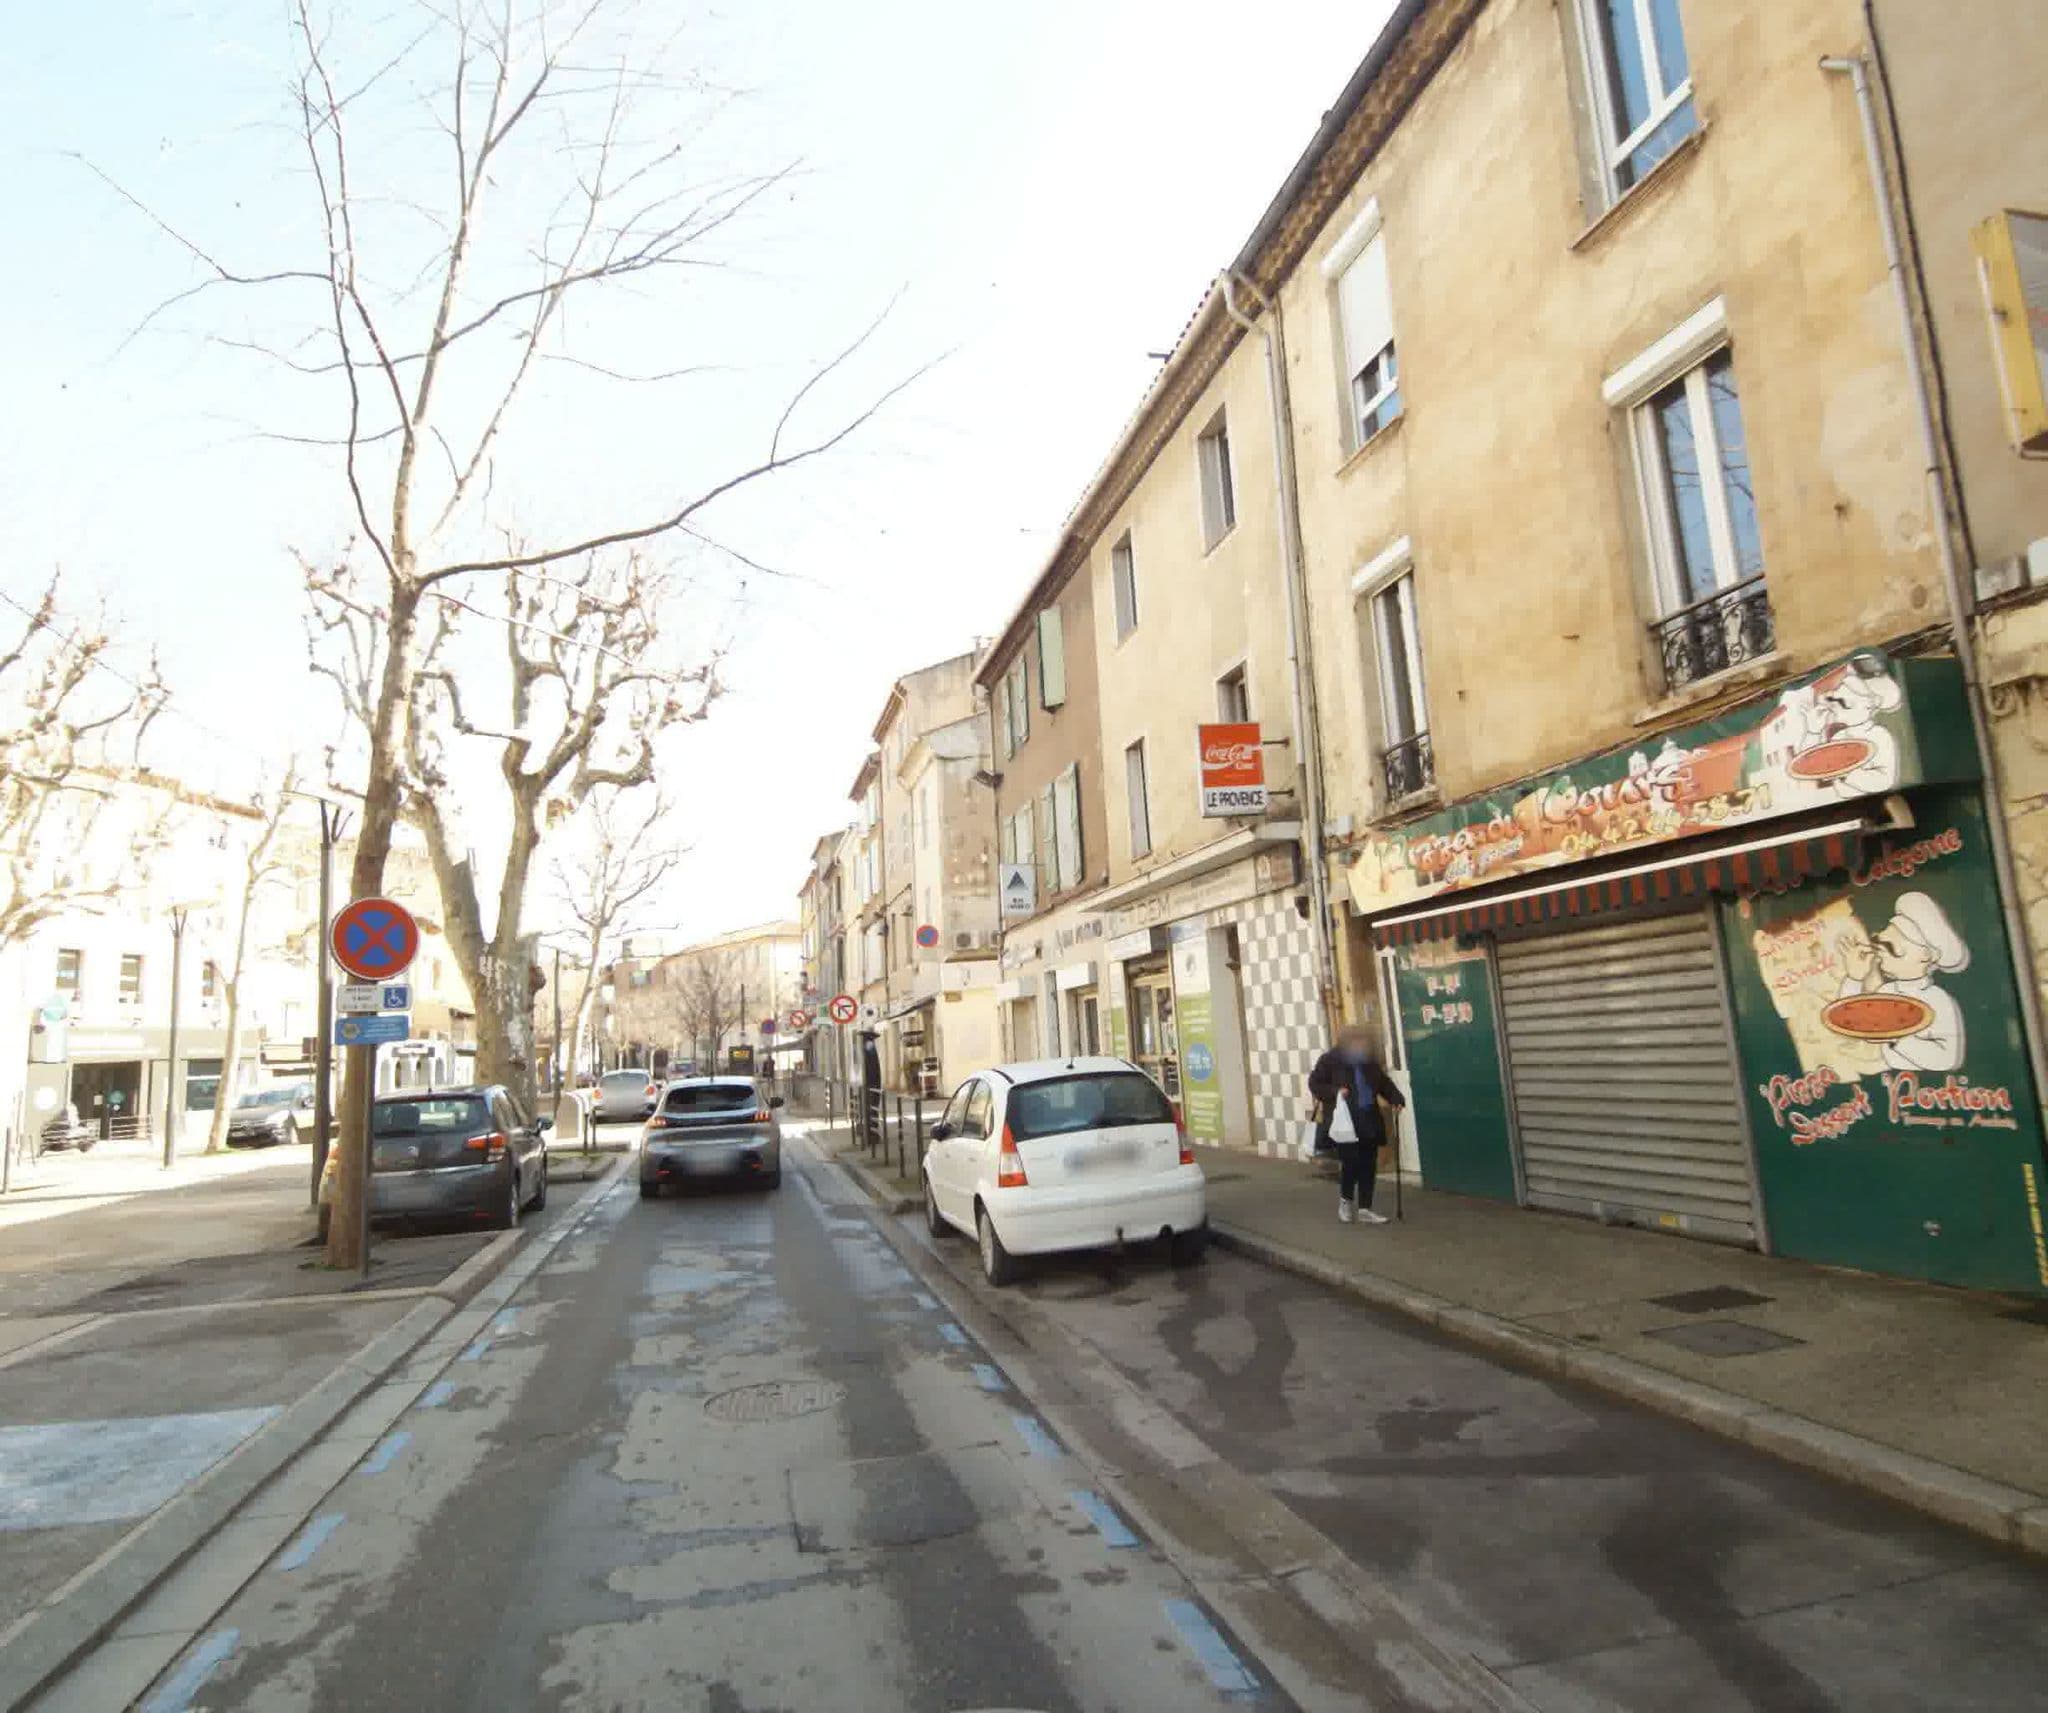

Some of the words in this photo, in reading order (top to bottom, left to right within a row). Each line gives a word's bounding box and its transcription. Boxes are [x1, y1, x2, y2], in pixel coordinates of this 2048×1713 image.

[1207, 792, 1218, 807] LE
[1219, 790, 1264, 806] PROVENCE
[1880, 1070, 2013, 1124] Portion
